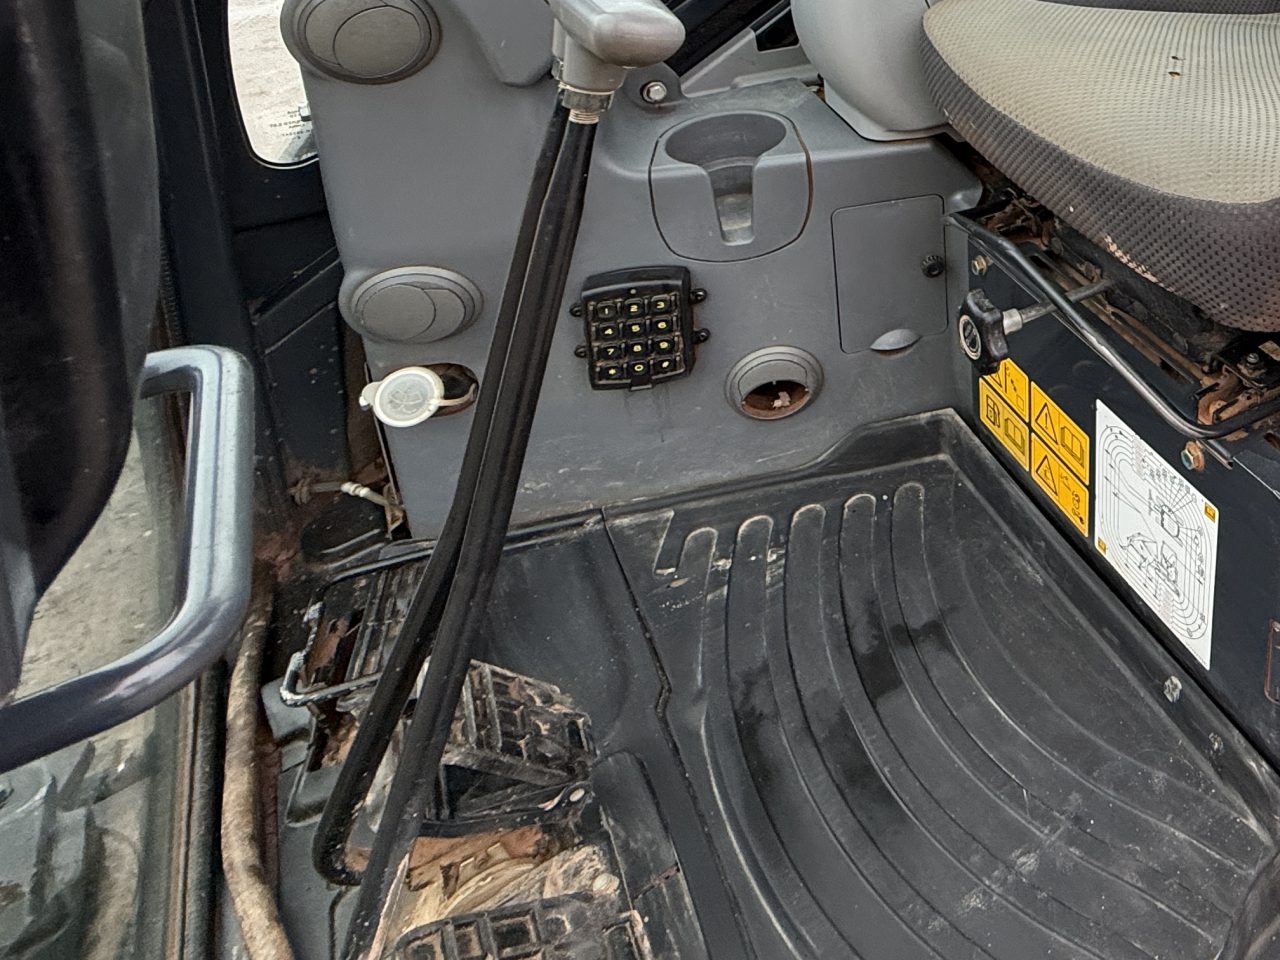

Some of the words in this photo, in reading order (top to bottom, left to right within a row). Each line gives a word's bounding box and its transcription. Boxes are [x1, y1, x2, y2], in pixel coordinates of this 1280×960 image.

[630, 304, 638, 312] 2
[656, 301, 665, 309] 3
[658, 321, 667, 329] 6
[633, 344, 642, 352] 8
[660, 341, 668, 349] 9
[634, 364, 644, 372] 0
